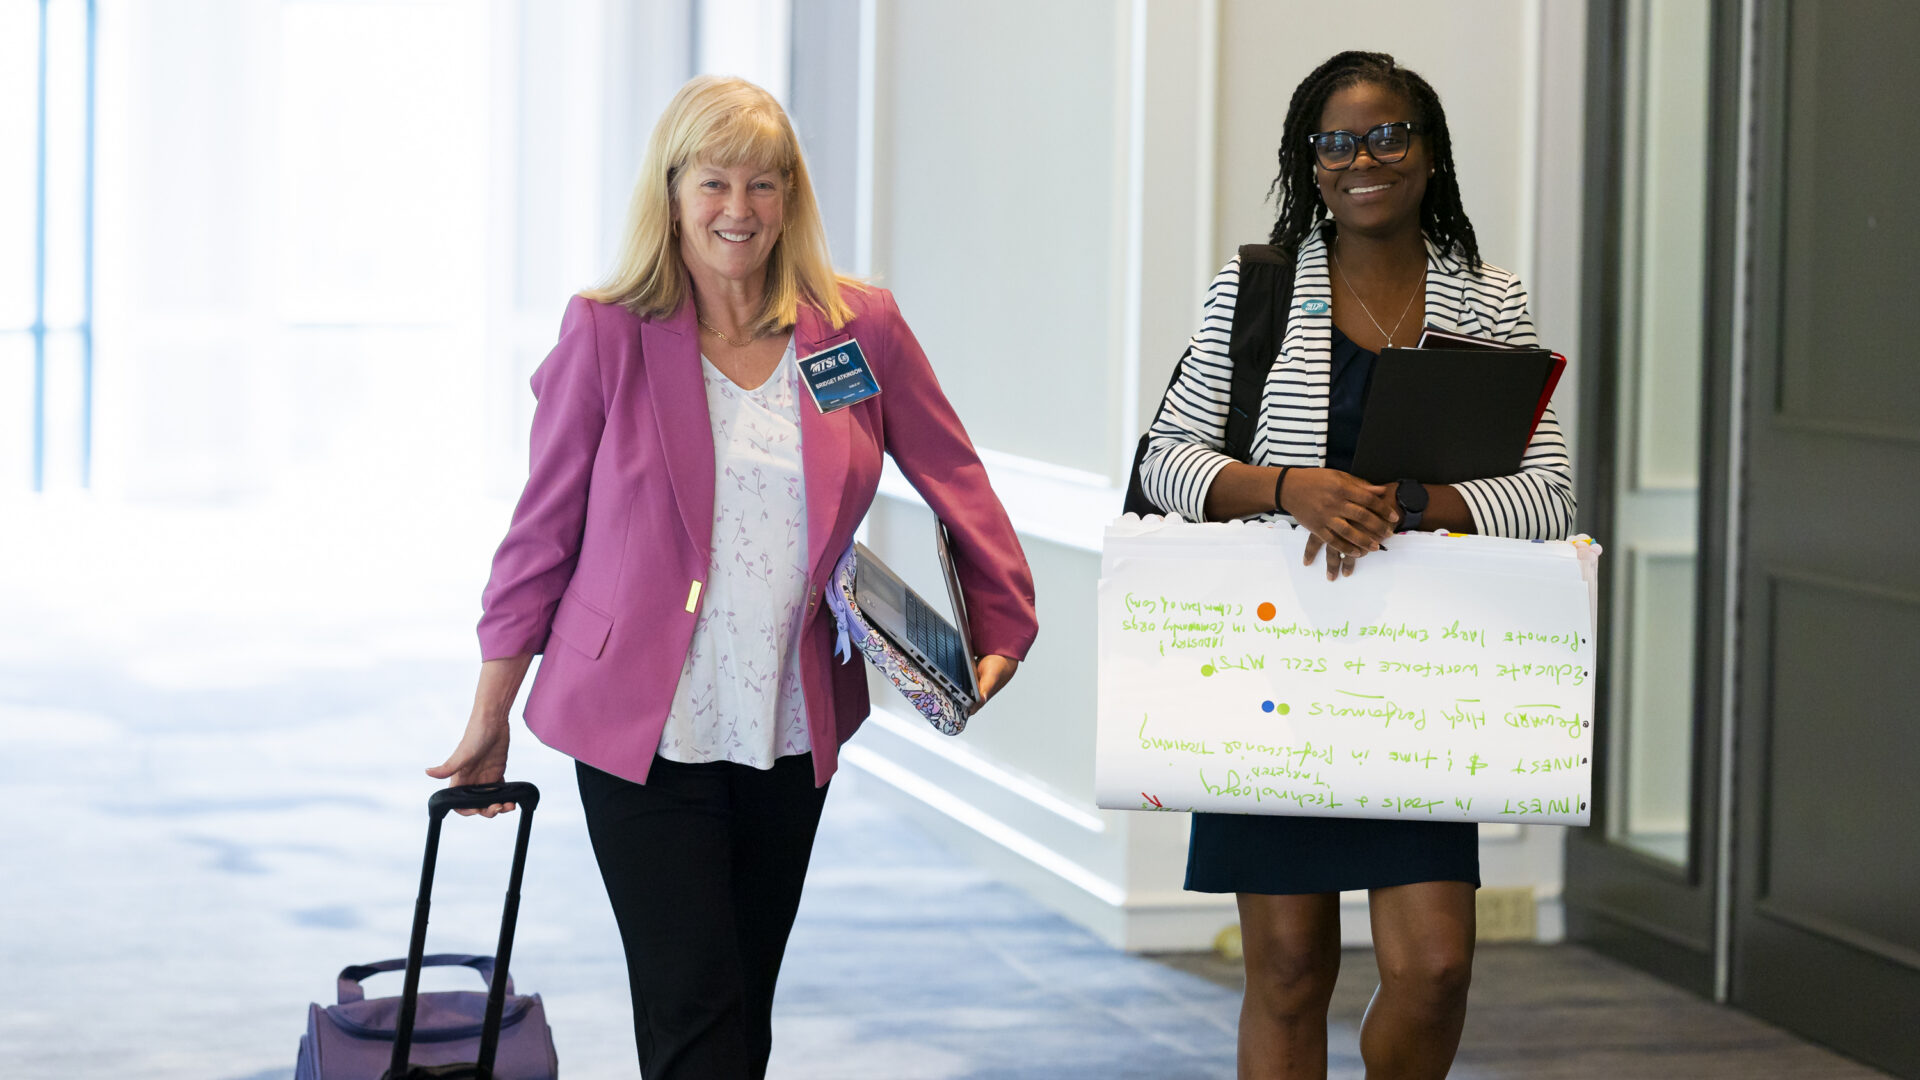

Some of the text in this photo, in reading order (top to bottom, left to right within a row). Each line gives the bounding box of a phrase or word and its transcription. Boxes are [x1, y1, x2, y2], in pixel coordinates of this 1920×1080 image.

[815, 378, 836, 389] BRIDGET
[837, 367, 862, 381] ATKINSON
[1232, 623, 1246, 633] in
[1279, 657, 1328, 673] SELL
[1343, 657, 1366, 675] to
[1439, 703, 1486, 730] High
[1351, 750, 1370, 766] in
[1381, 796, 1445, 815] tools
[1455, 797, 1473, 815] in
